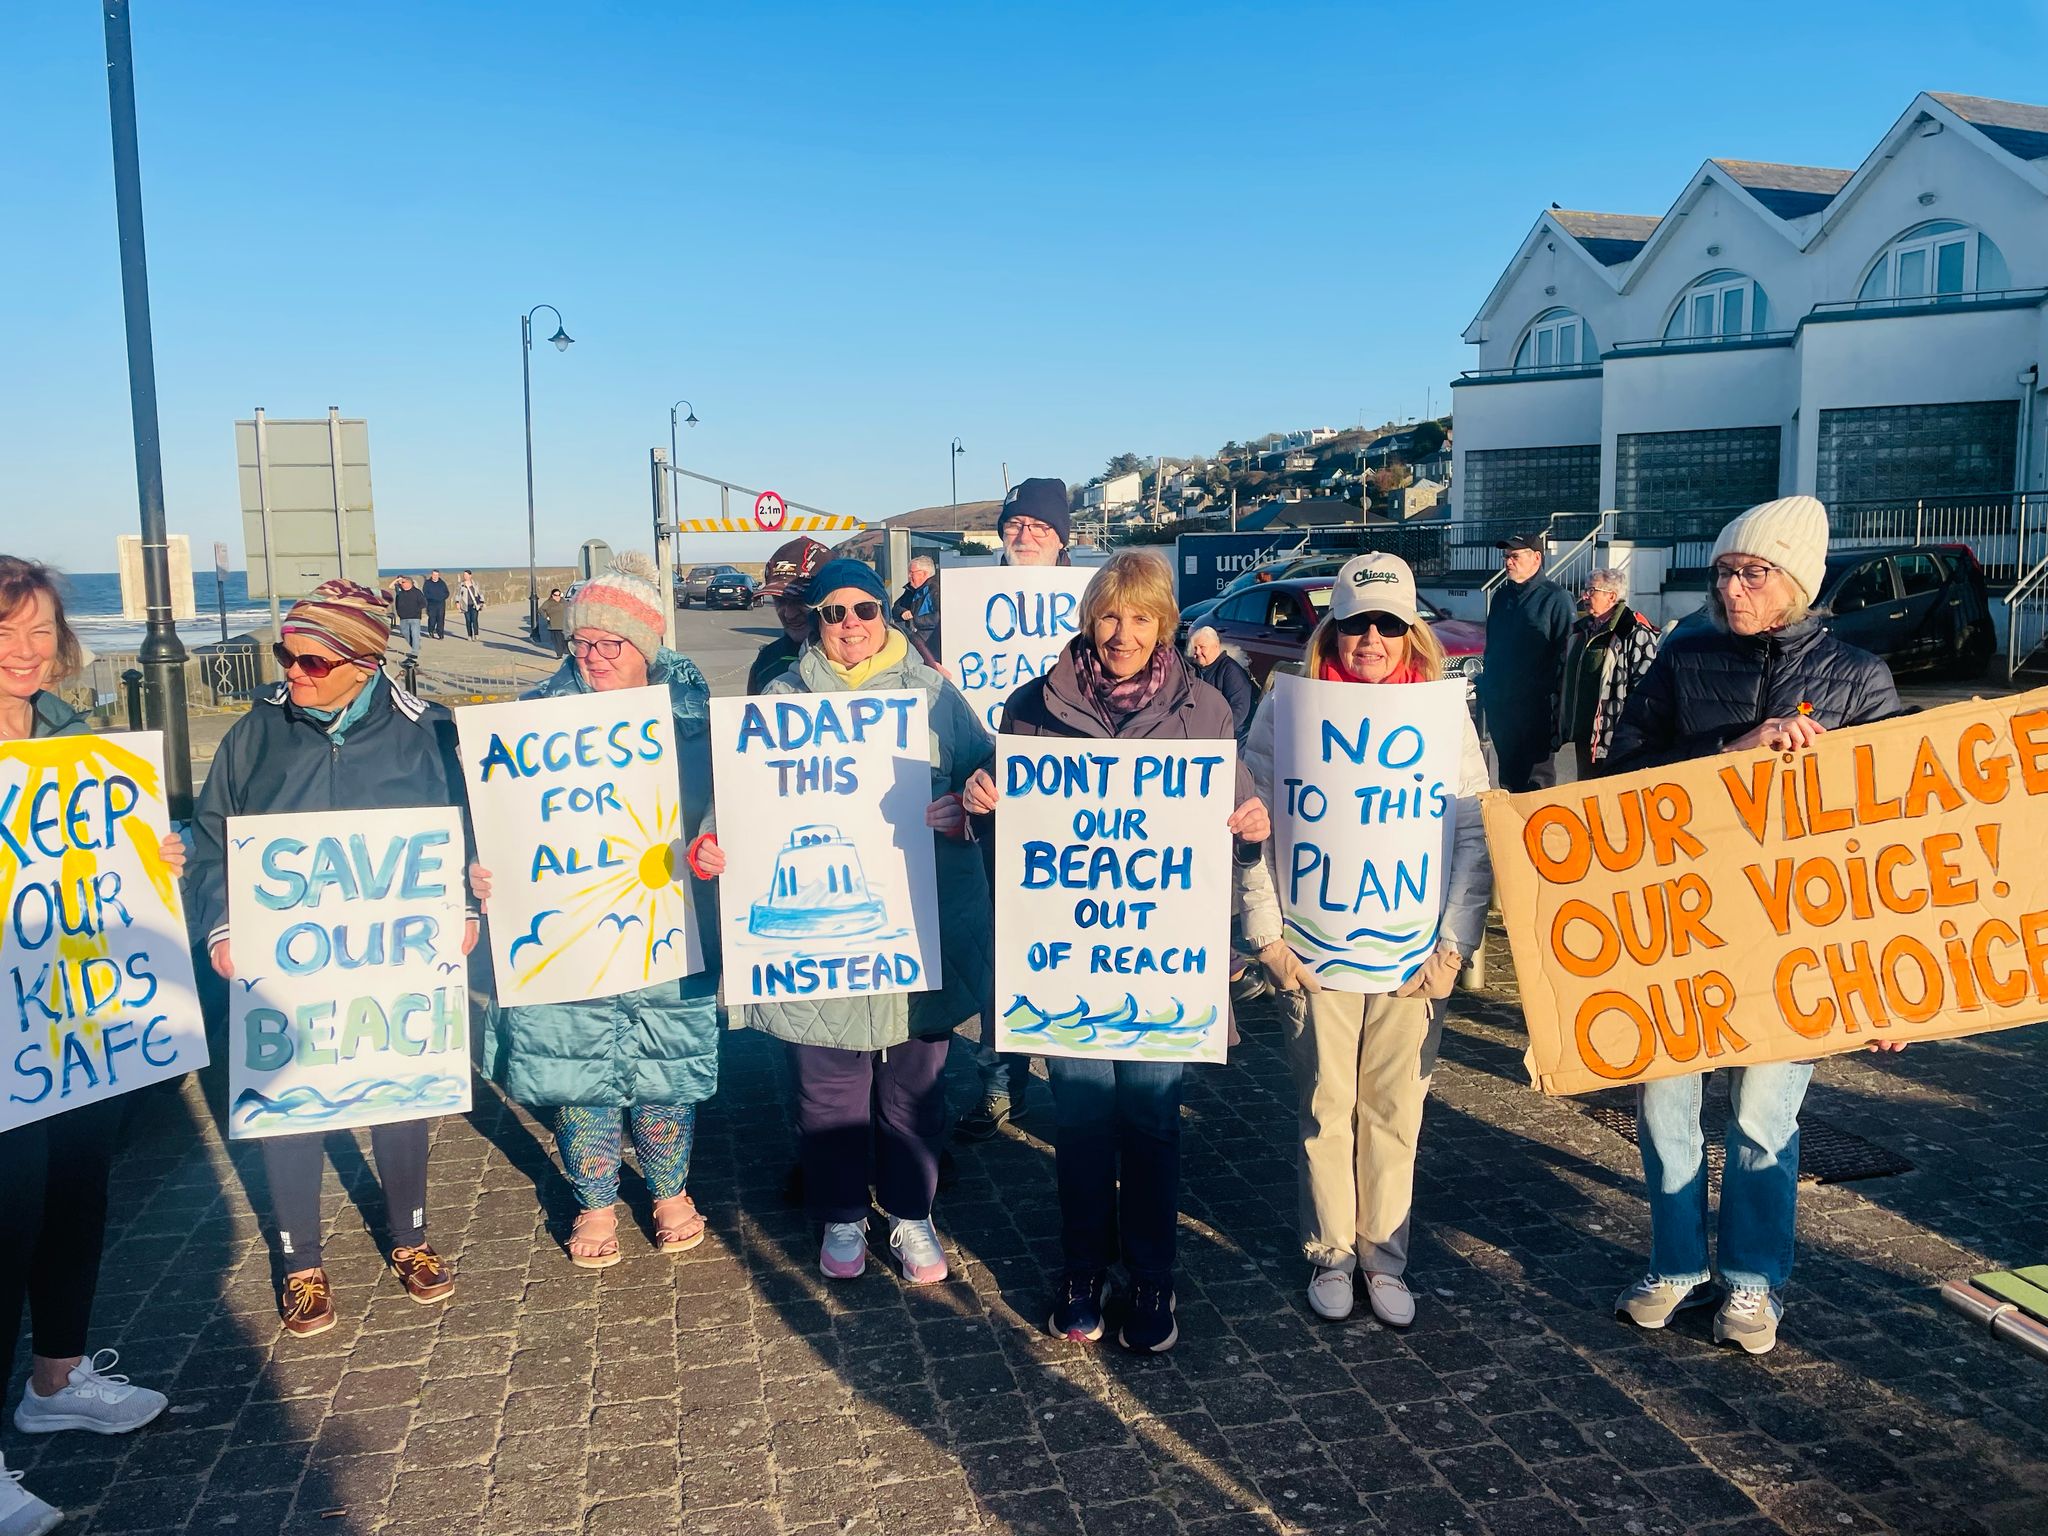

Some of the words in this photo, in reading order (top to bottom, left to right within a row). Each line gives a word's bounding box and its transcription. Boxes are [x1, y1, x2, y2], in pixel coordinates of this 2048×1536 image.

[759, 505, 781, 515] 2.1m
[1215, 547, 1275, 572] urchi
[1353, 568, 1398, 584] Chicago
[985, 590, 1082, 642] OUR
[959, 651, 1059, 691] BEAC
[480, 718, 664, 783] ACCESS
[736, 697, 918, 753] ADAPT
[1321, 717, 1426, 770] NO
[541, 781, 624, 822] FOR
[767, 755, 859, 798] THIS
[1005, 751, 1119, 800] DON'T
[1133, 753, 1224, 799] PUT
[1283, 777, 1328, 823] TO
[0, 775, 139, 869] KEEP
[1073, 807, 1149, 842] OUR
[1523, 782, 1707, 885] OUR
[254, 829, 450, 910] SAVE
[531, 838, 625, 883] ALL
[1020, 840, 1193, 891] BEACH
[1290, 842, 1429, 915] PLAN
[13, 871, 134, 951] OUR
[1074, 898, 1158, 930] OUT
[1551, 873, 1729, 978] OUR
[275, 914, 440, 977] OUR
[1027, 942, 1072, 972] OF
[1091, 945, 1207, 975] REACH
[10, 951, 158, 1033] KIDS
[752, 953, 921, 997] INSTEAD
[243, 985, 466, 1072] BEACH
[1574, 970, 1752, 1081] OUR
[10, 1015, 178, 1105] SAFE
